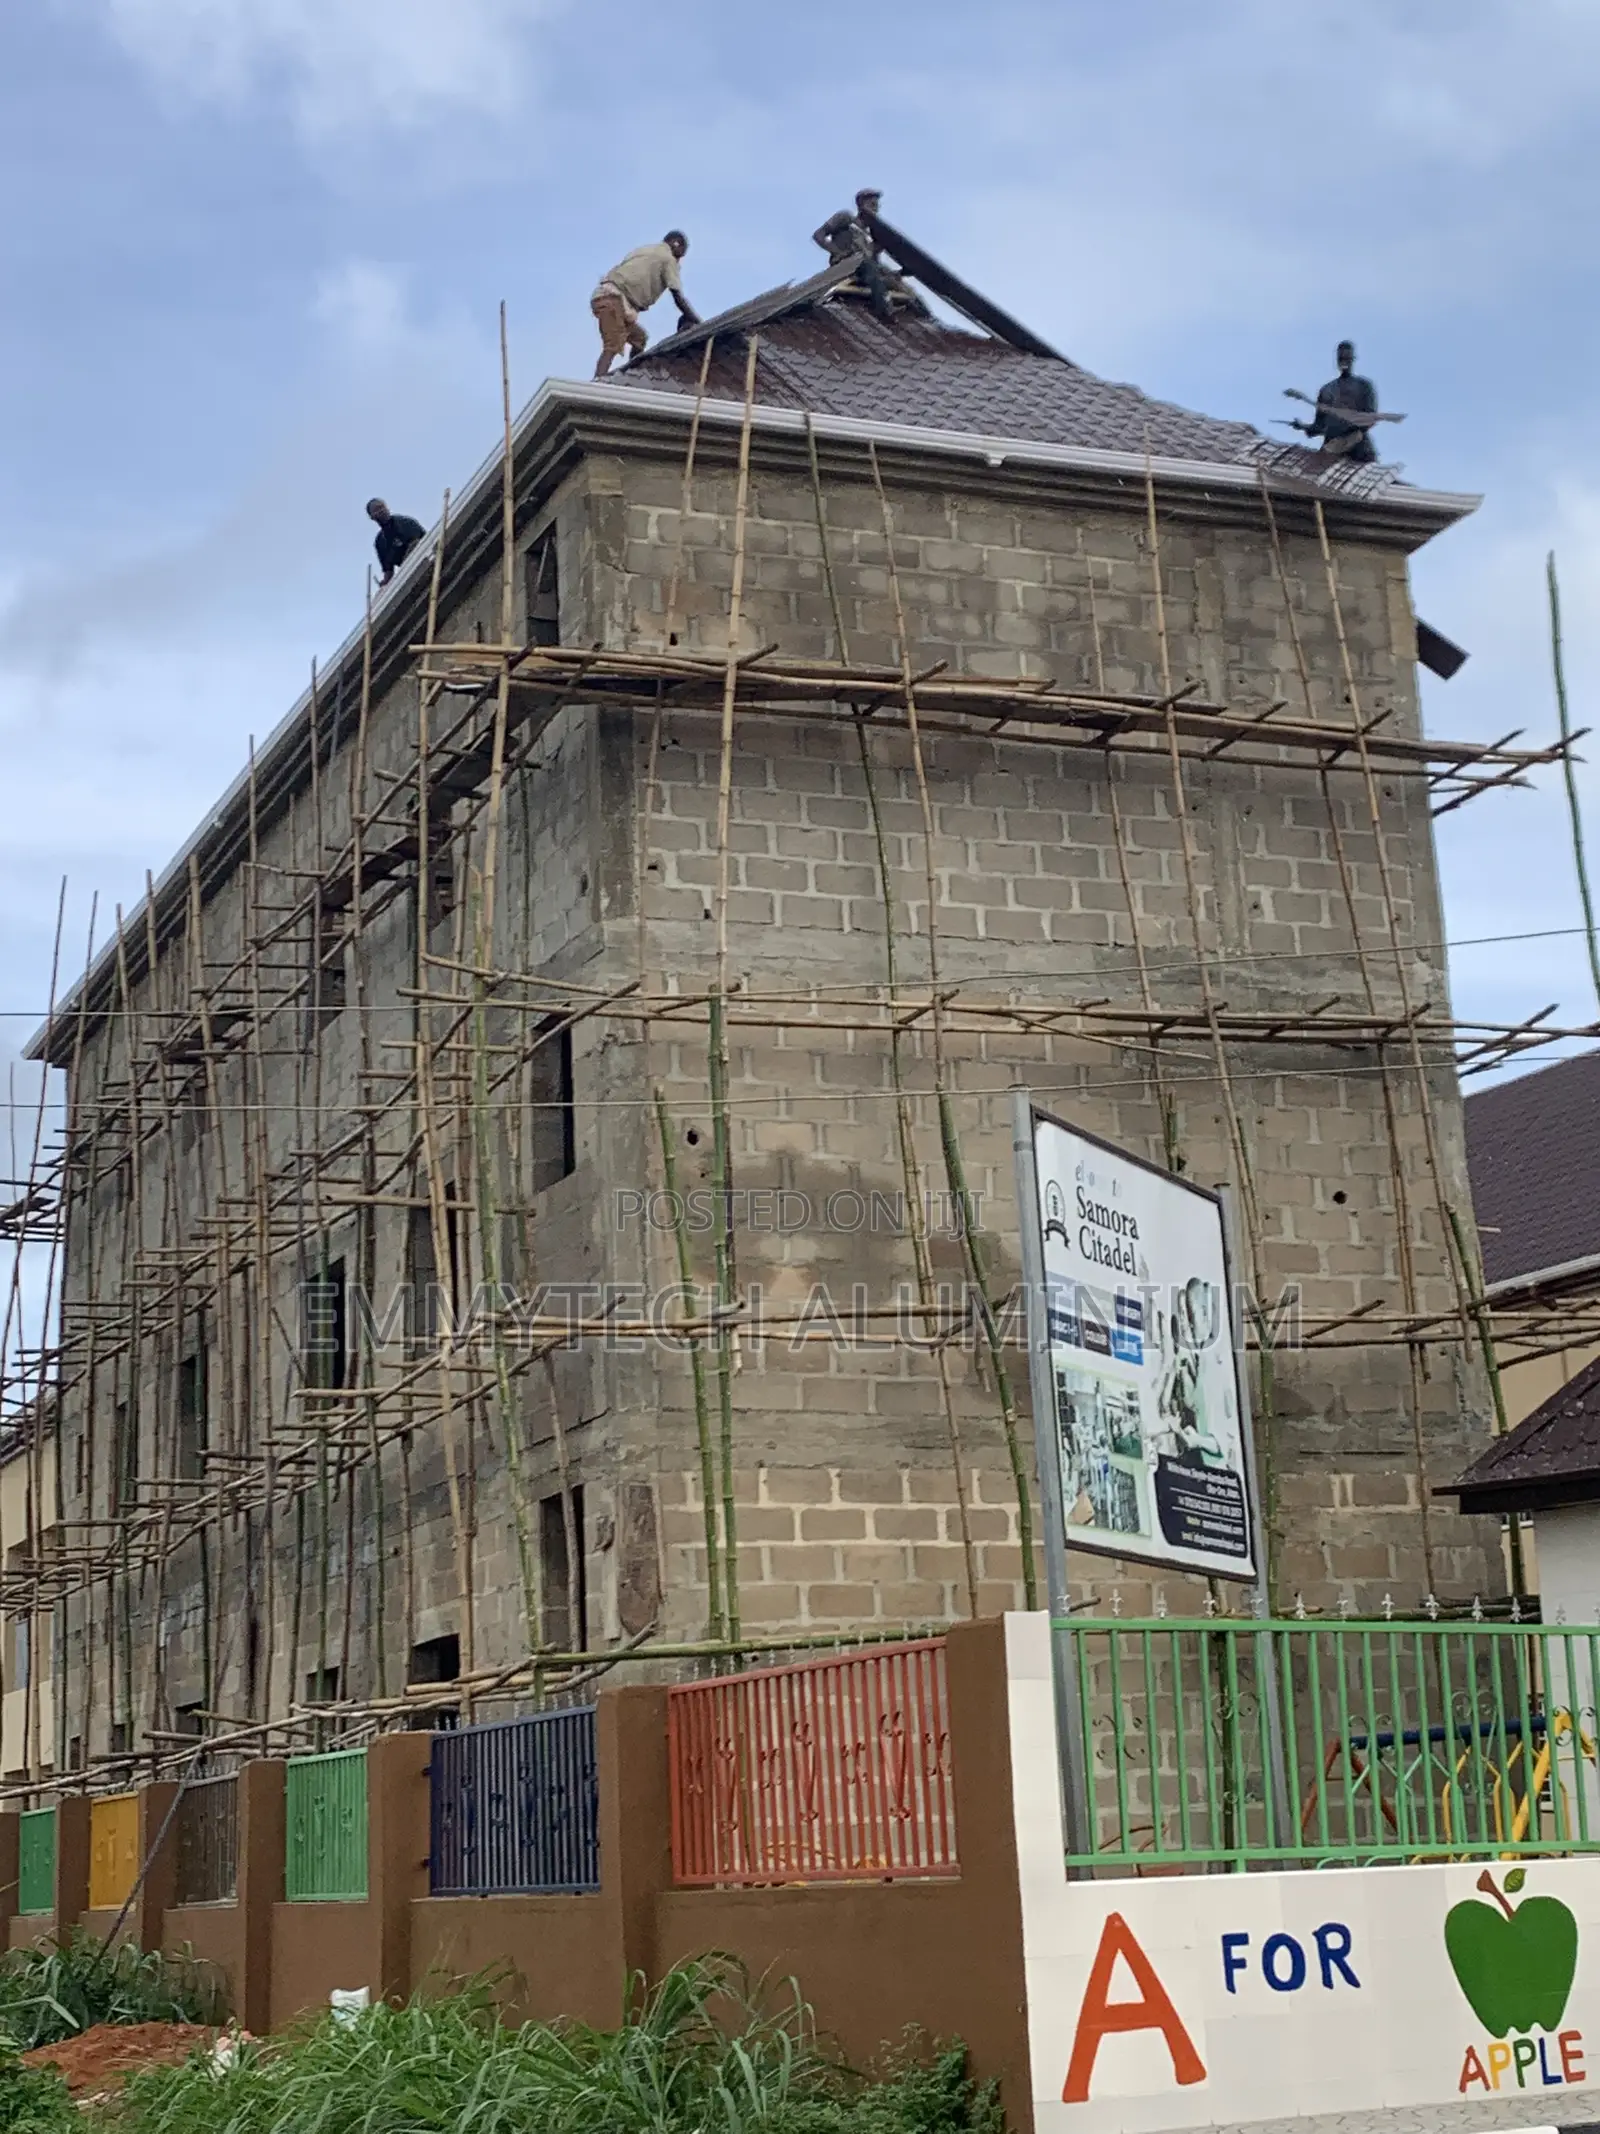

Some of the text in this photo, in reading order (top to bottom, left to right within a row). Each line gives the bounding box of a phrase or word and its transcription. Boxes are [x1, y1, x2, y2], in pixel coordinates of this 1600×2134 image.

[1076, 1185, 1140, 1240] Samora
[1079, 1225, 1138, 1277] Citadel
[1062, 1911, 1362, 2103] A FOR
[1459, 2030, 1588, 2094] APPLE
